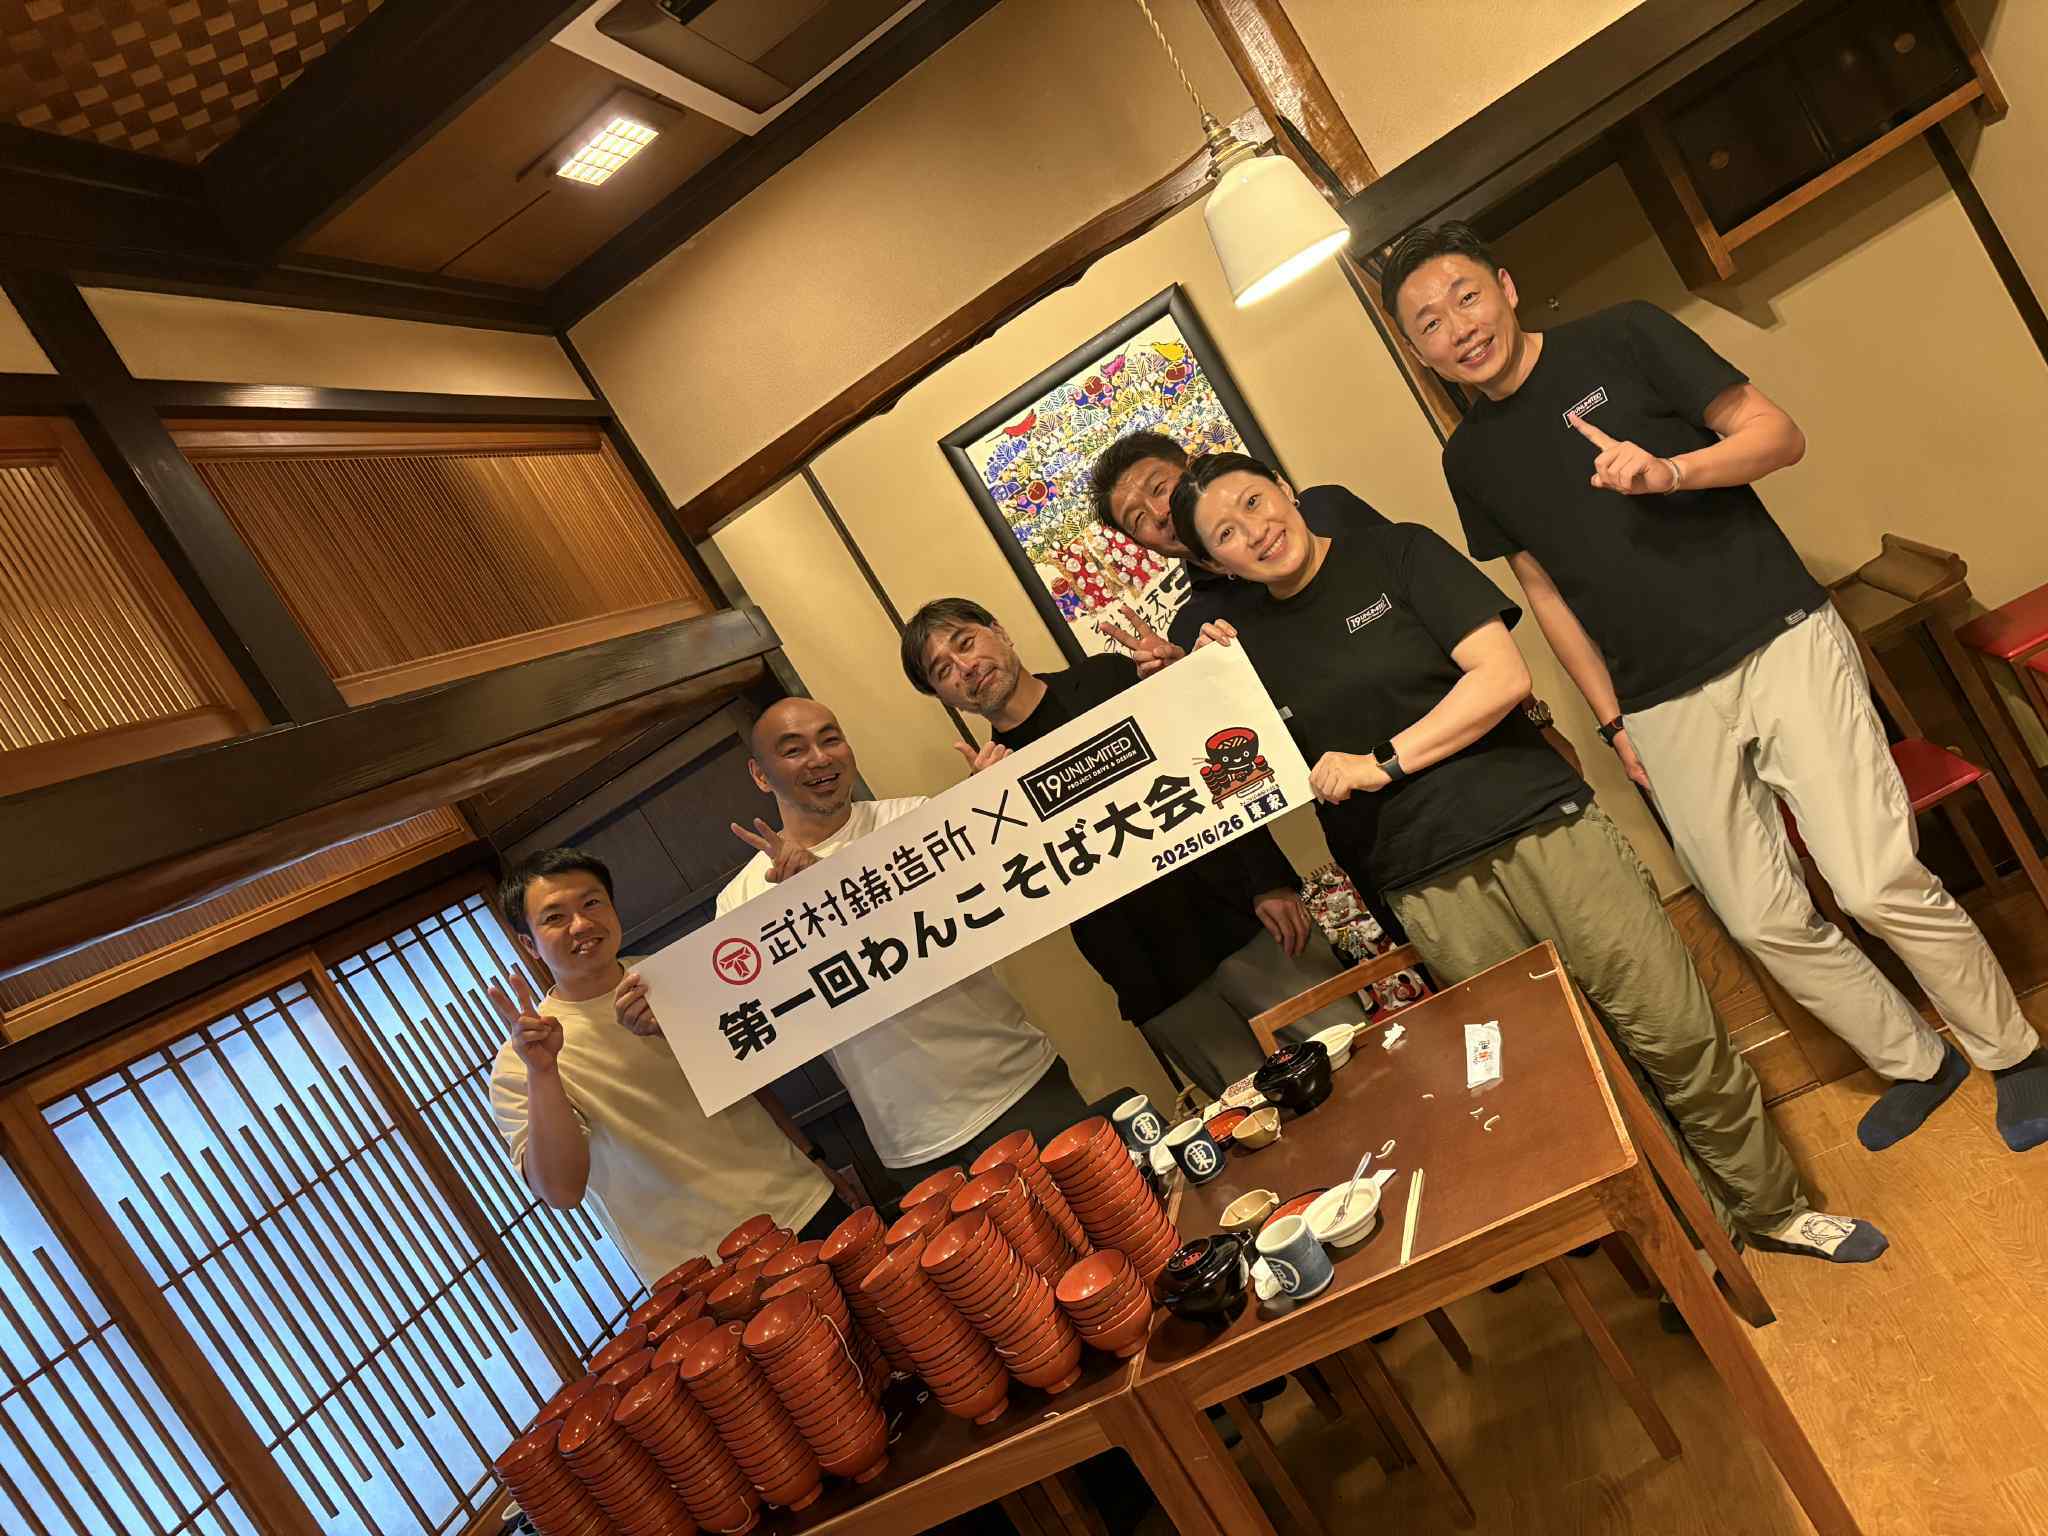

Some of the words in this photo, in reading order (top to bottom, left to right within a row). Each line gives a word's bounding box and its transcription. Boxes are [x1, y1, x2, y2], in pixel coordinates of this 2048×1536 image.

[1067, 773, 1093, 791] PROJECT
[1116, 749, 1138, 764] DESIGN
[1150, 813, 1245, 873] 2025/6/26
[717, 774, 1206, 1062] 第一回わんこそば大会
[1188, 1142, 1213, 1170] 東
